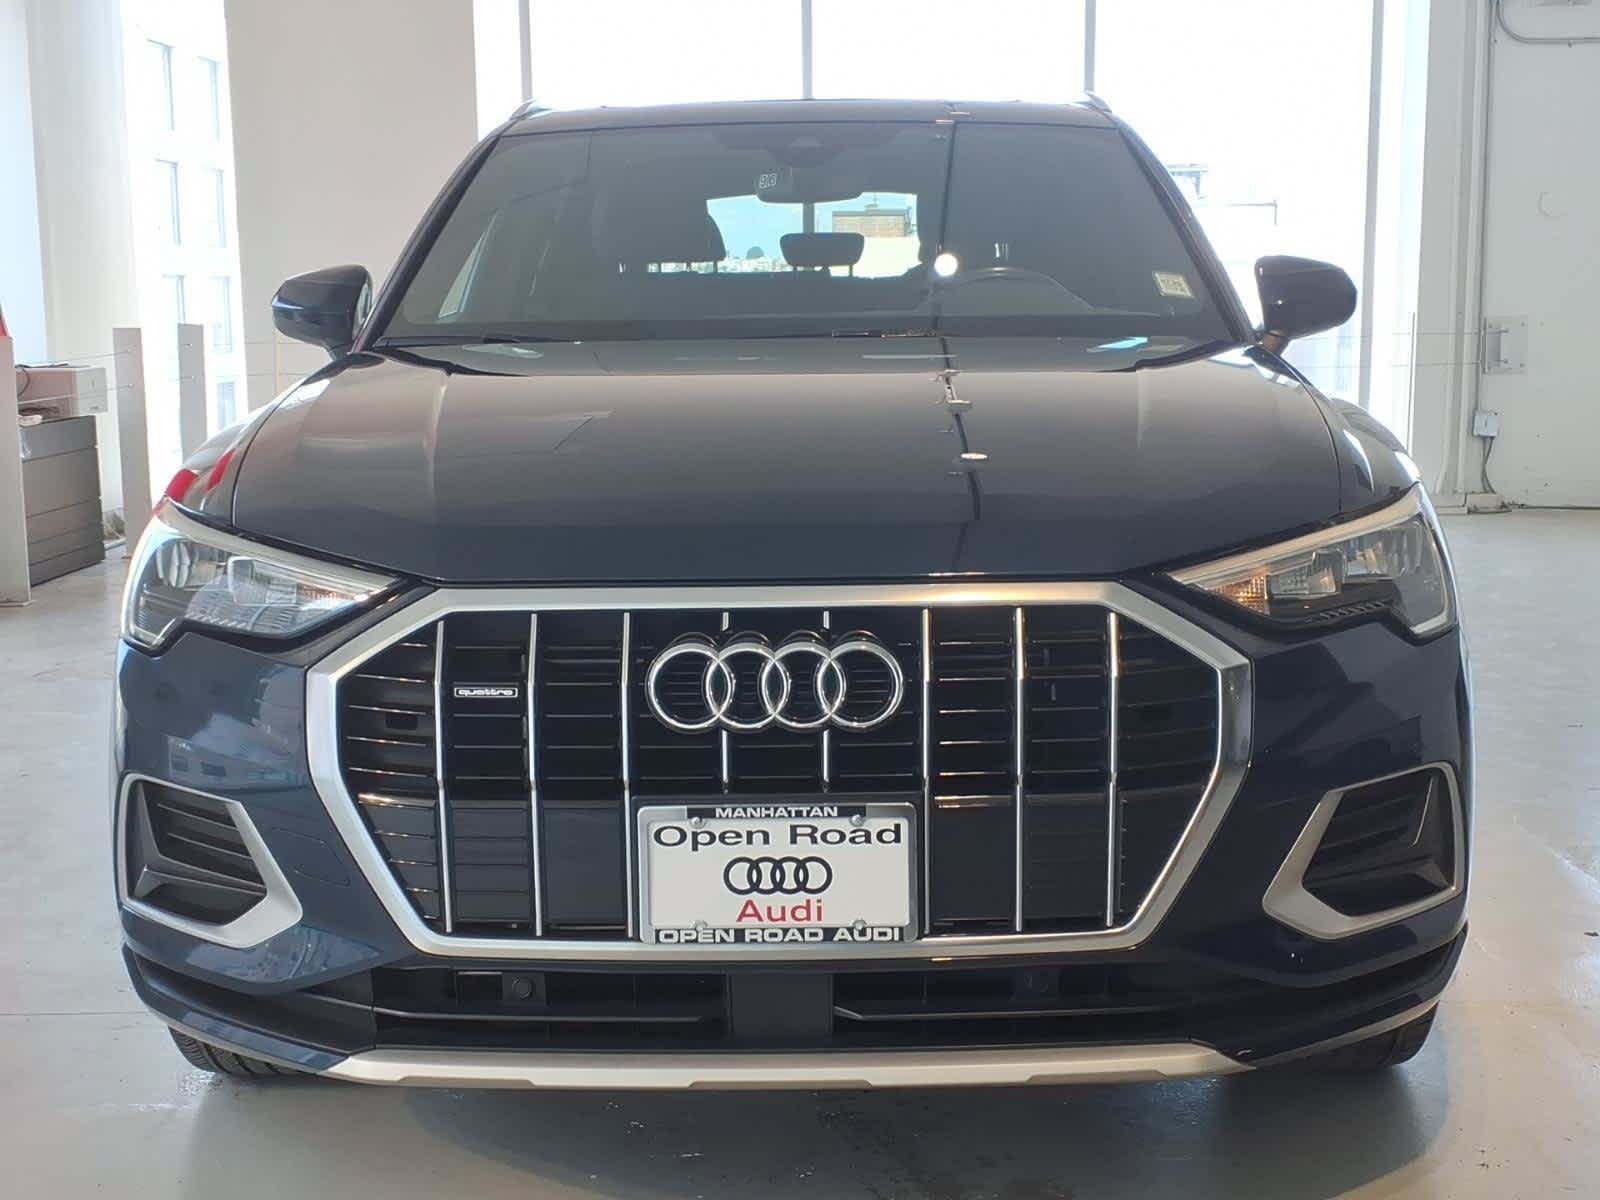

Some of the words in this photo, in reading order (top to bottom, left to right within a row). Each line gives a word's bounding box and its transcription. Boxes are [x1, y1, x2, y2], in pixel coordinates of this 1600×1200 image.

[458, 689, 513, 697] quattro
[715, 806, 838, 818] MANHATTAN
[653, 825, 770, 851] Open
[789, 823, 901, 845] Road
[736, 899, 822, 922] Audi
[659, 928, 735, 943] OPEN
[745, 928, 824, 943] ROAD
[833, 927, 899, 942] AUDI
